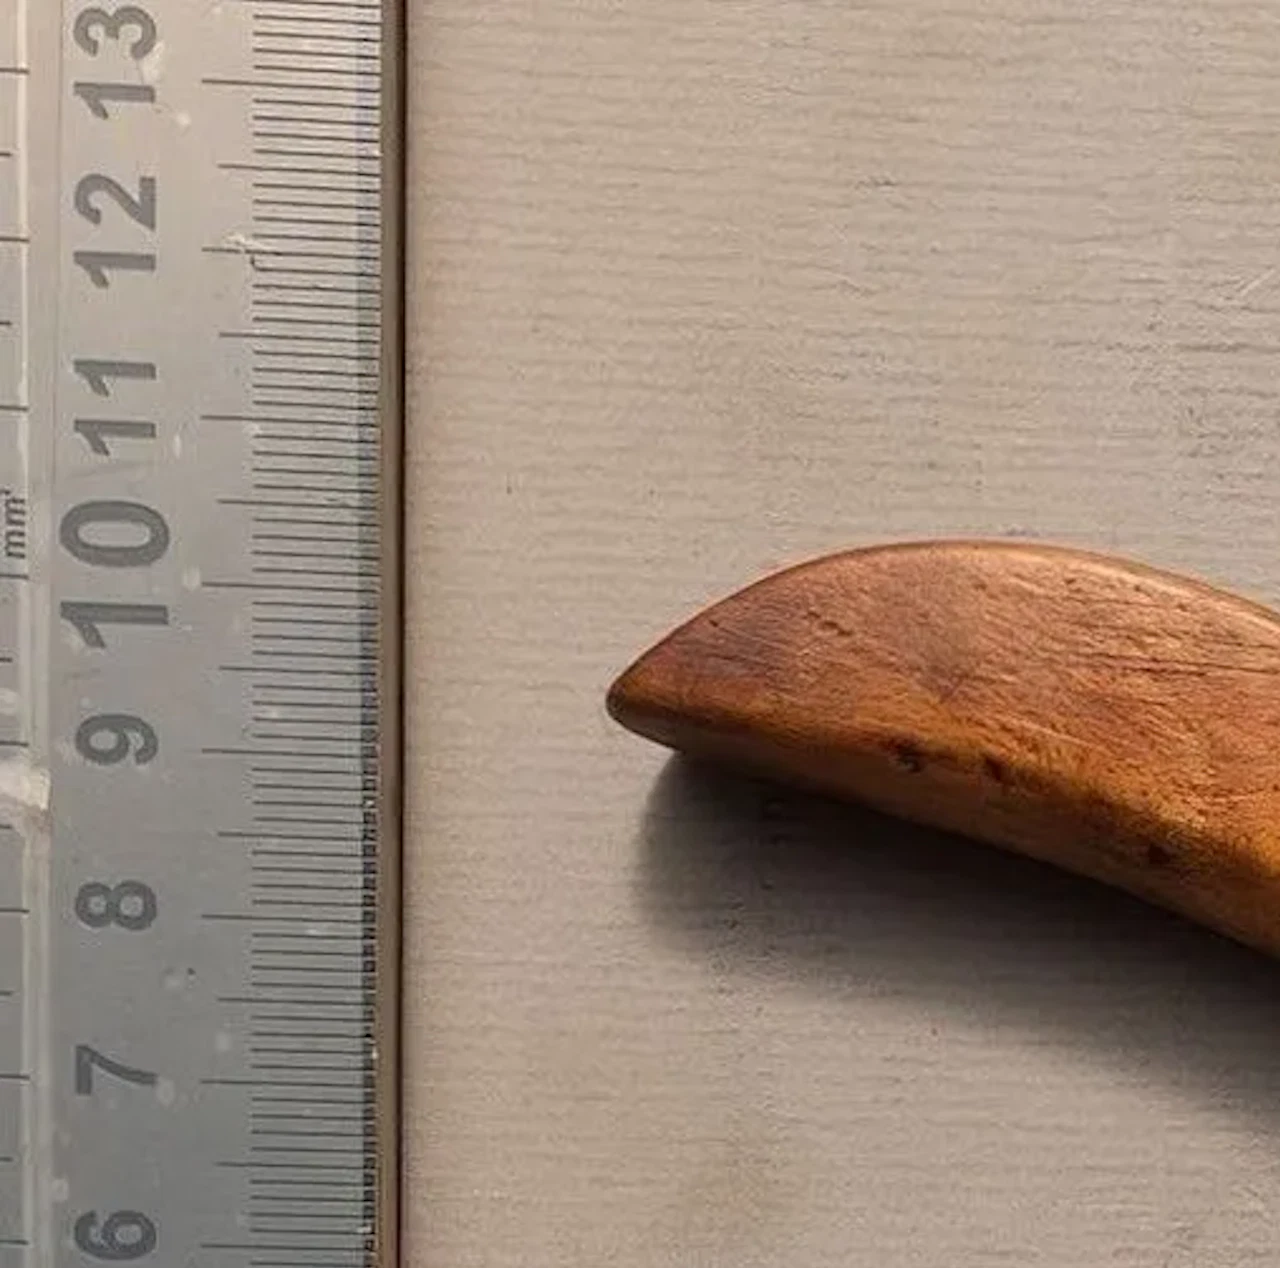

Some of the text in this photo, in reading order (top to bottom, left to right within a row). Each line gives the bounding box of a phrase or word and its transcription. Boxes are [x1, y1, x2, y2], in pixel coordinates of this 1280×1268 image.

[73, 6, 156, 119] 13
[73, 173, 156, 289] 12
[73, 359, 156, 456] 11
[59, 500, 170, 649] 10
[75, 713, 158, 765] 9
[75, 881, 157, 930] 8
[75, 1044, 158, 1095] 7
[74, 1210, 157, 1260] 6
